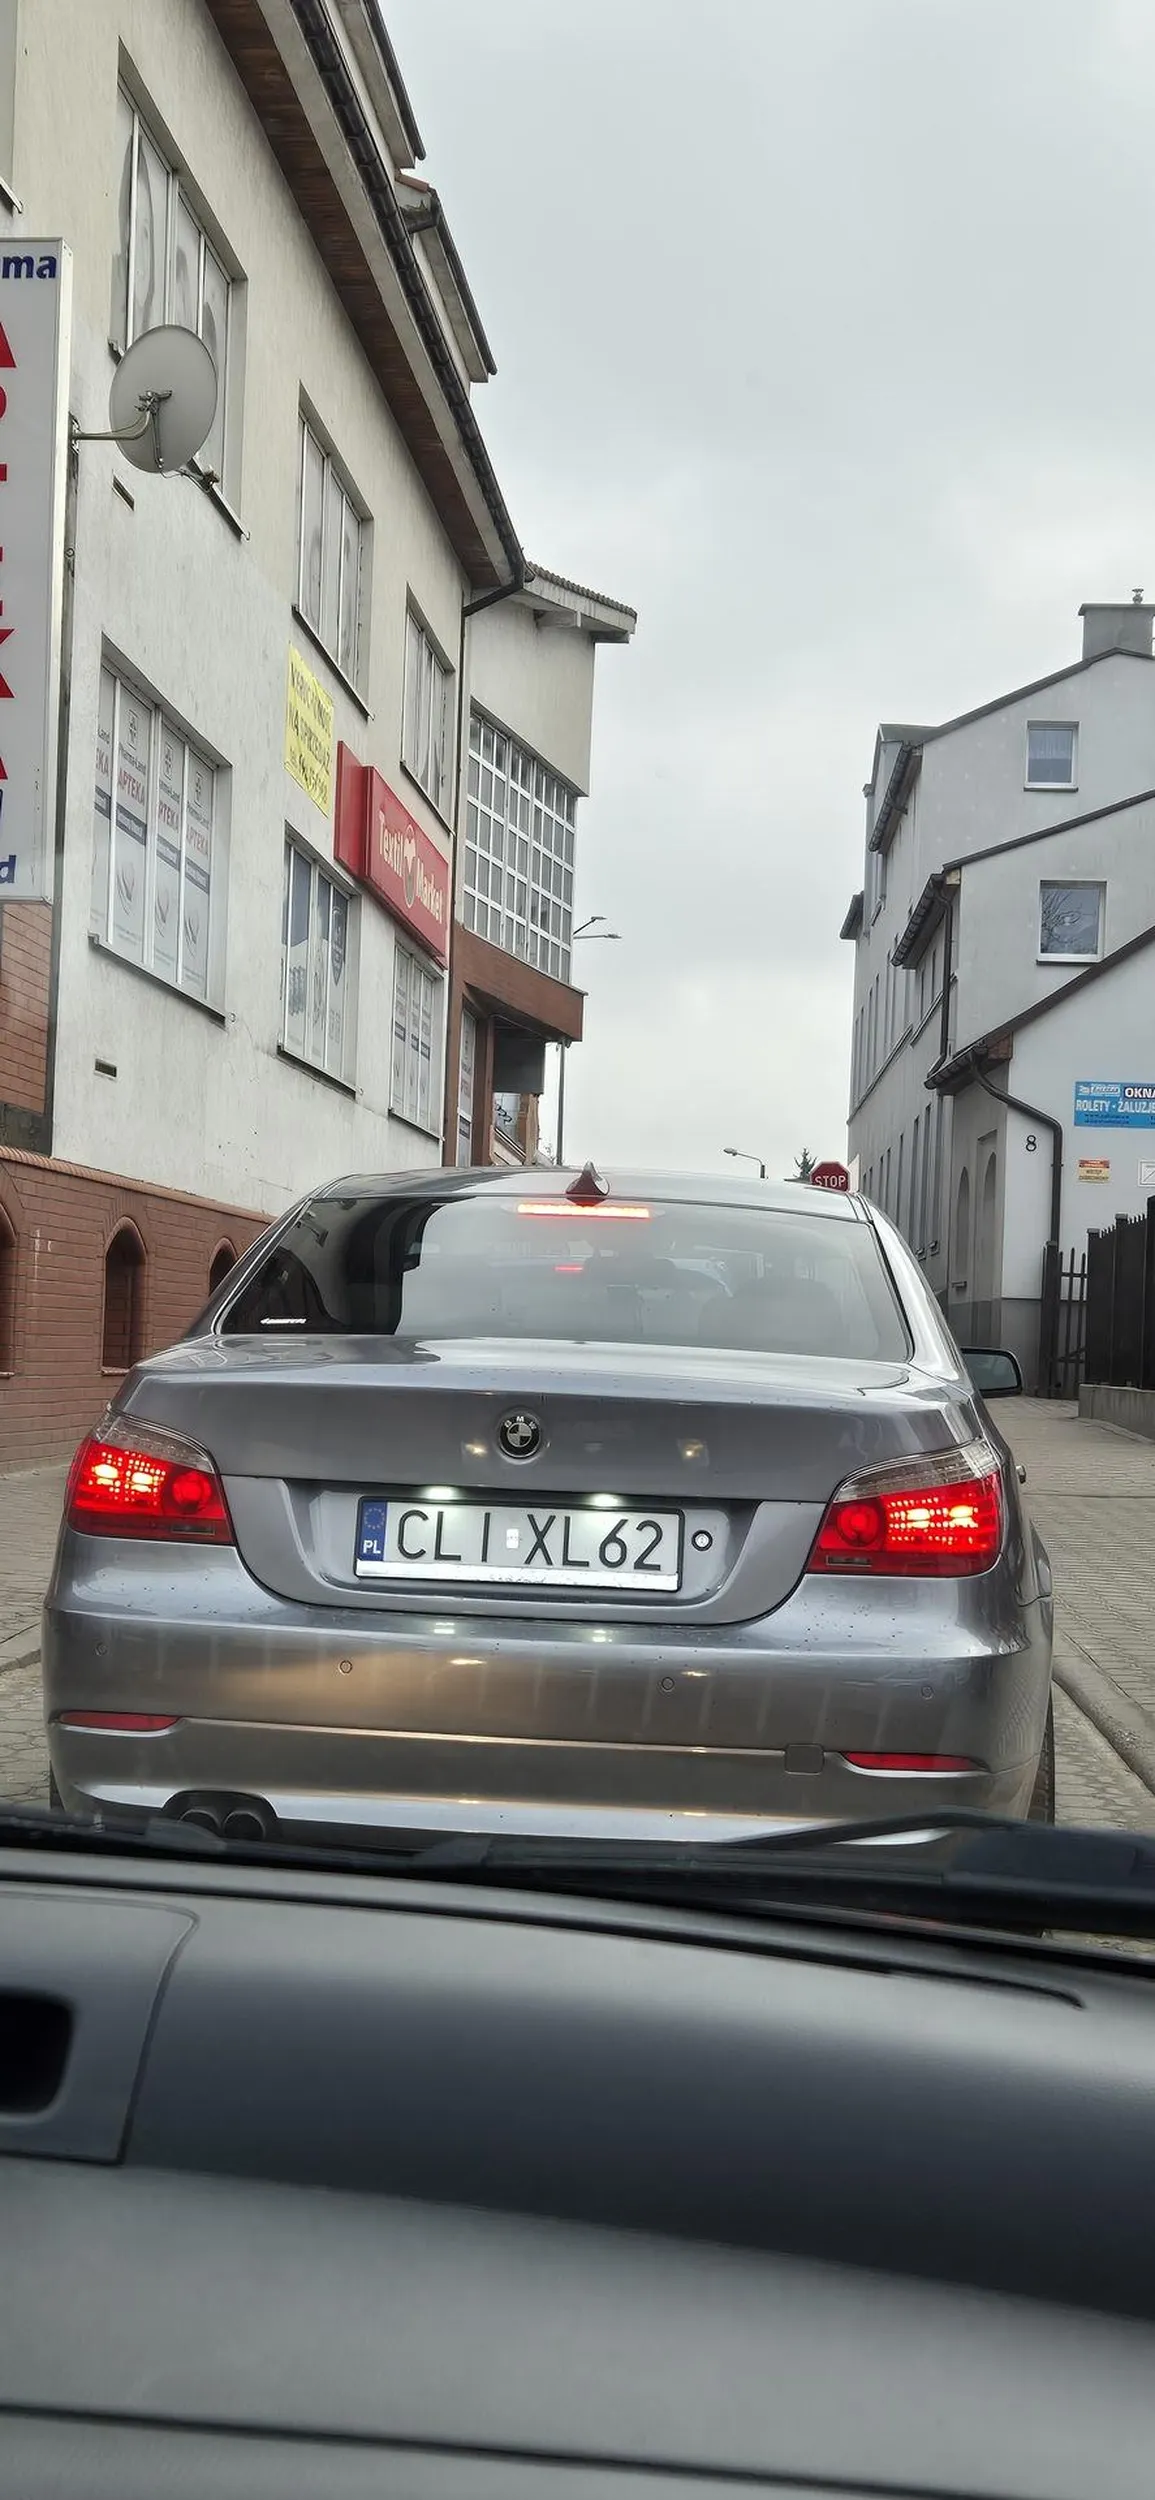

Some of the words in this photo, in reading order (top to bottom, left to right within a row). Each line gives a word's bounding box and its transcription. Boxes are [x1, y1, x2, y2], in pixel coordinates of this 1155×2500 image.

[118, 767, 146, 807] APTEKA
[158, 799, 180, 834] PTEKA
[379, 810, 404, 878] Textil
[416, 856, 443, 925] Market
[1076, 1099, 1111, 1112] ROLETY
[1025, 1134, 1037, 1152] 8
[814, 1175, 846, 1187] STOP
[362, 1540, 381, 1555] PL
[524, 1513, 664, 1572] XL62
